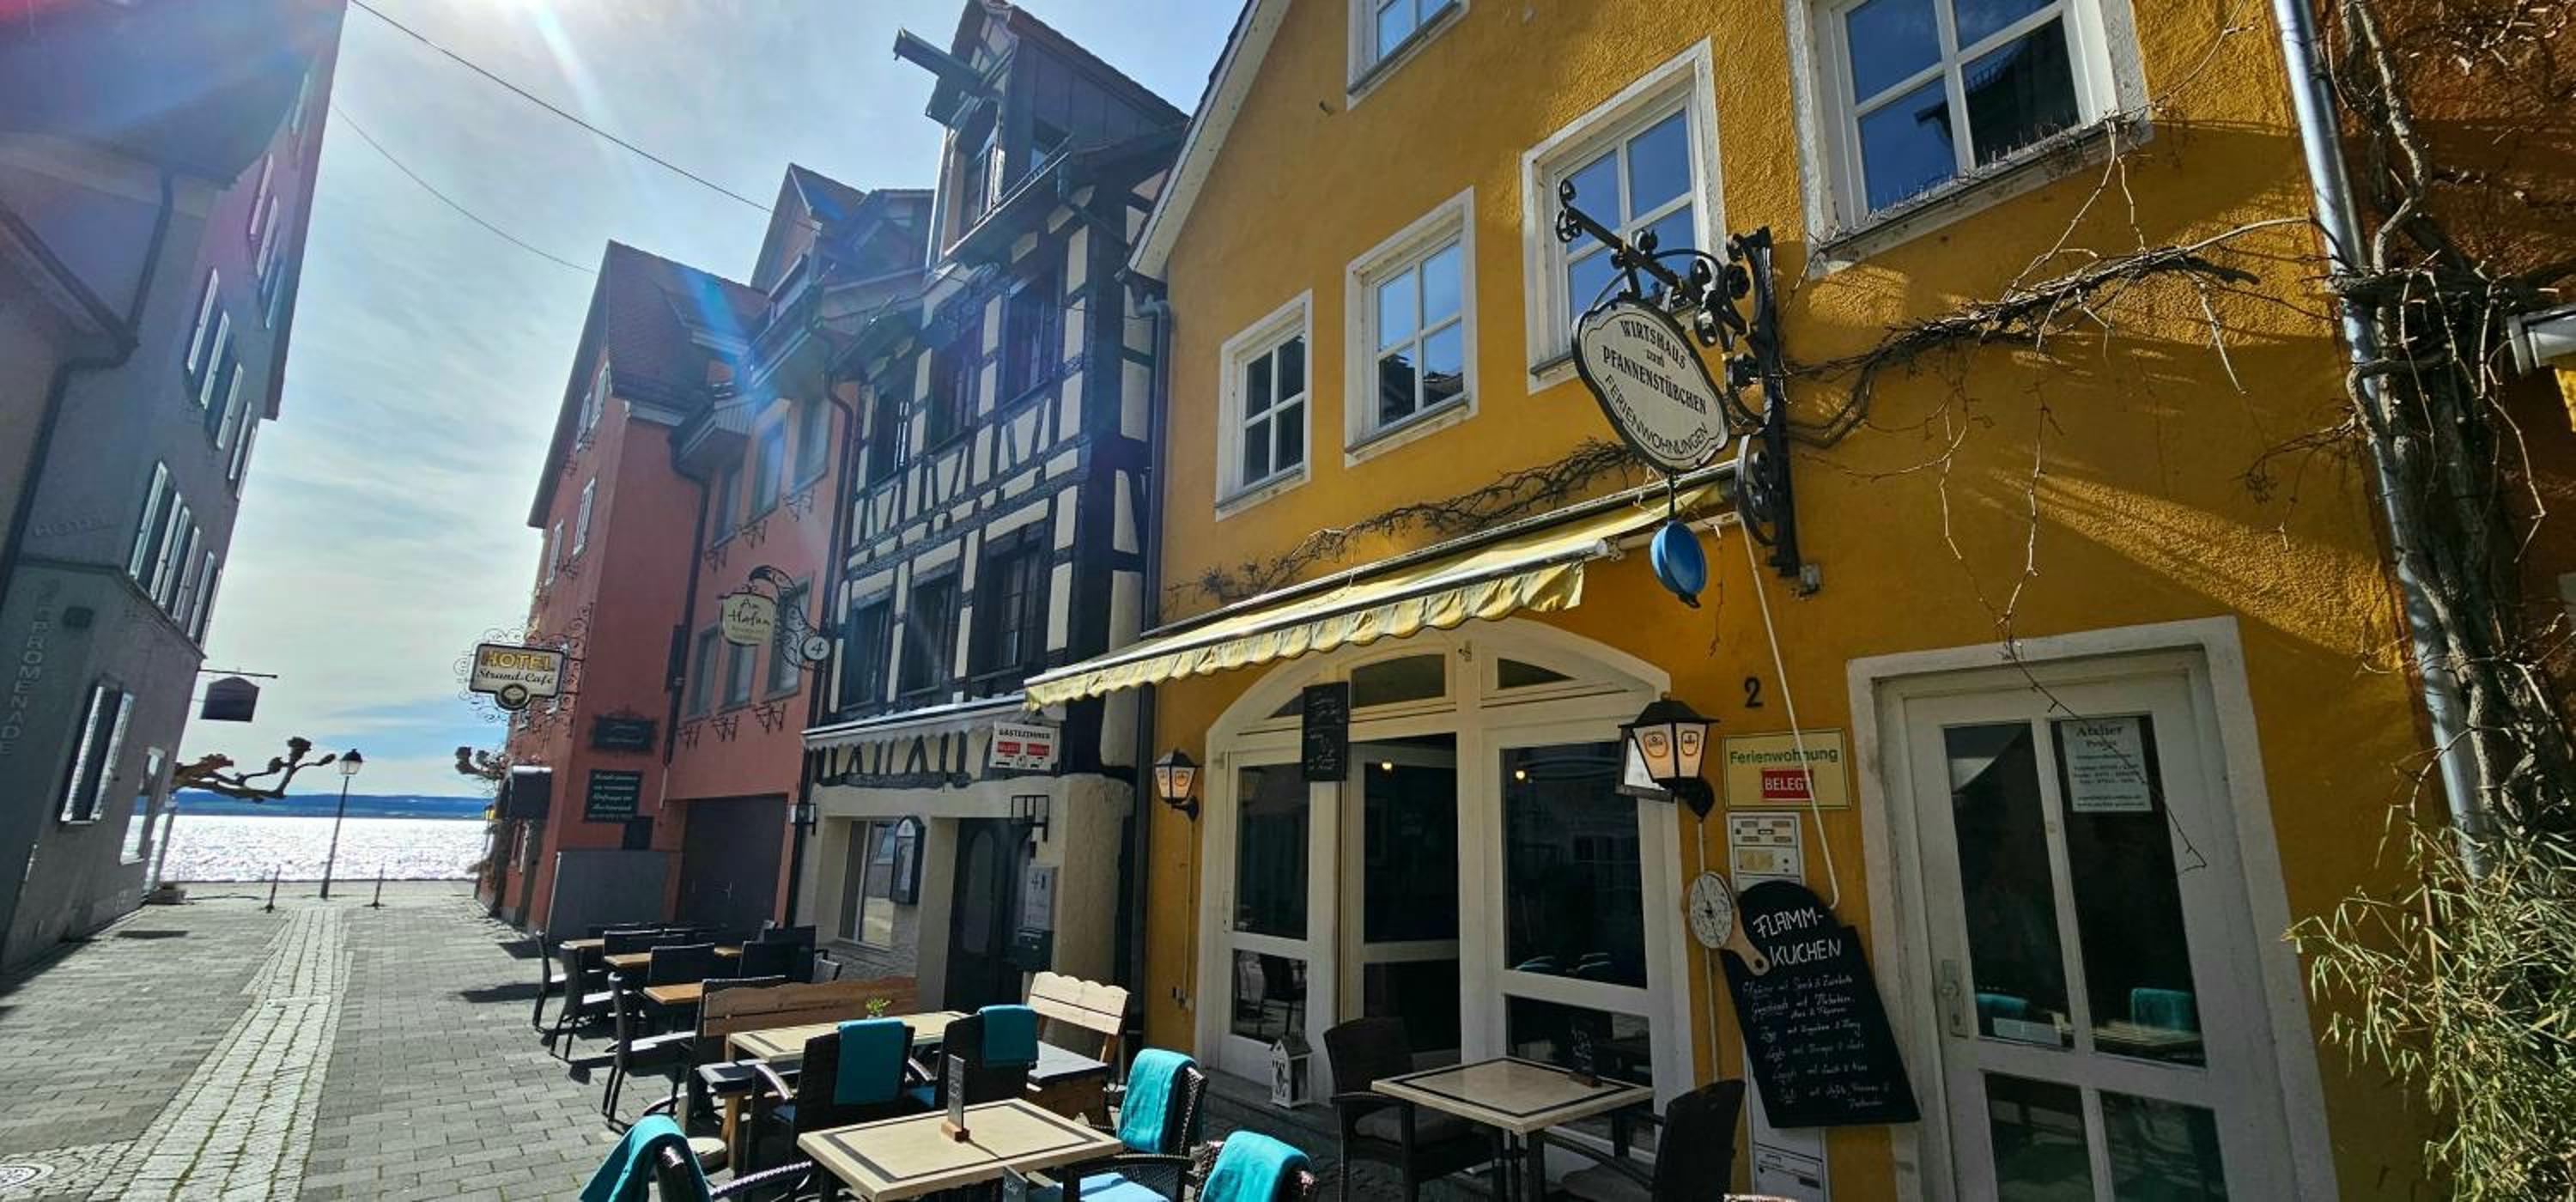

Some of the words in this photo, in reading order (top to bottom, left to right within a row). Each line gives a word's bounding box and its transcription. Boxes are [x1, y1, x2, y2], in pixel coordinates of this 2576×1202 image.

[1620, 320, 1686, 370] WIRTSHAUS
[1602, 345, 1707, 415] PFANNENSTÜBCHEN
[1605, 373, 1708, 455] FERIENWOHNUNGEN
[481, 650, 555, 672] HOTEL
[810, 641, 823, 655] 4
[1744, 677, 1764, 708] 2
[1729, 747, 1839, 765] Ferienwohnung
[1753, 906, 1824, 938] FLAMM-
[1769, 938, 1841, 968] KUCHEN
